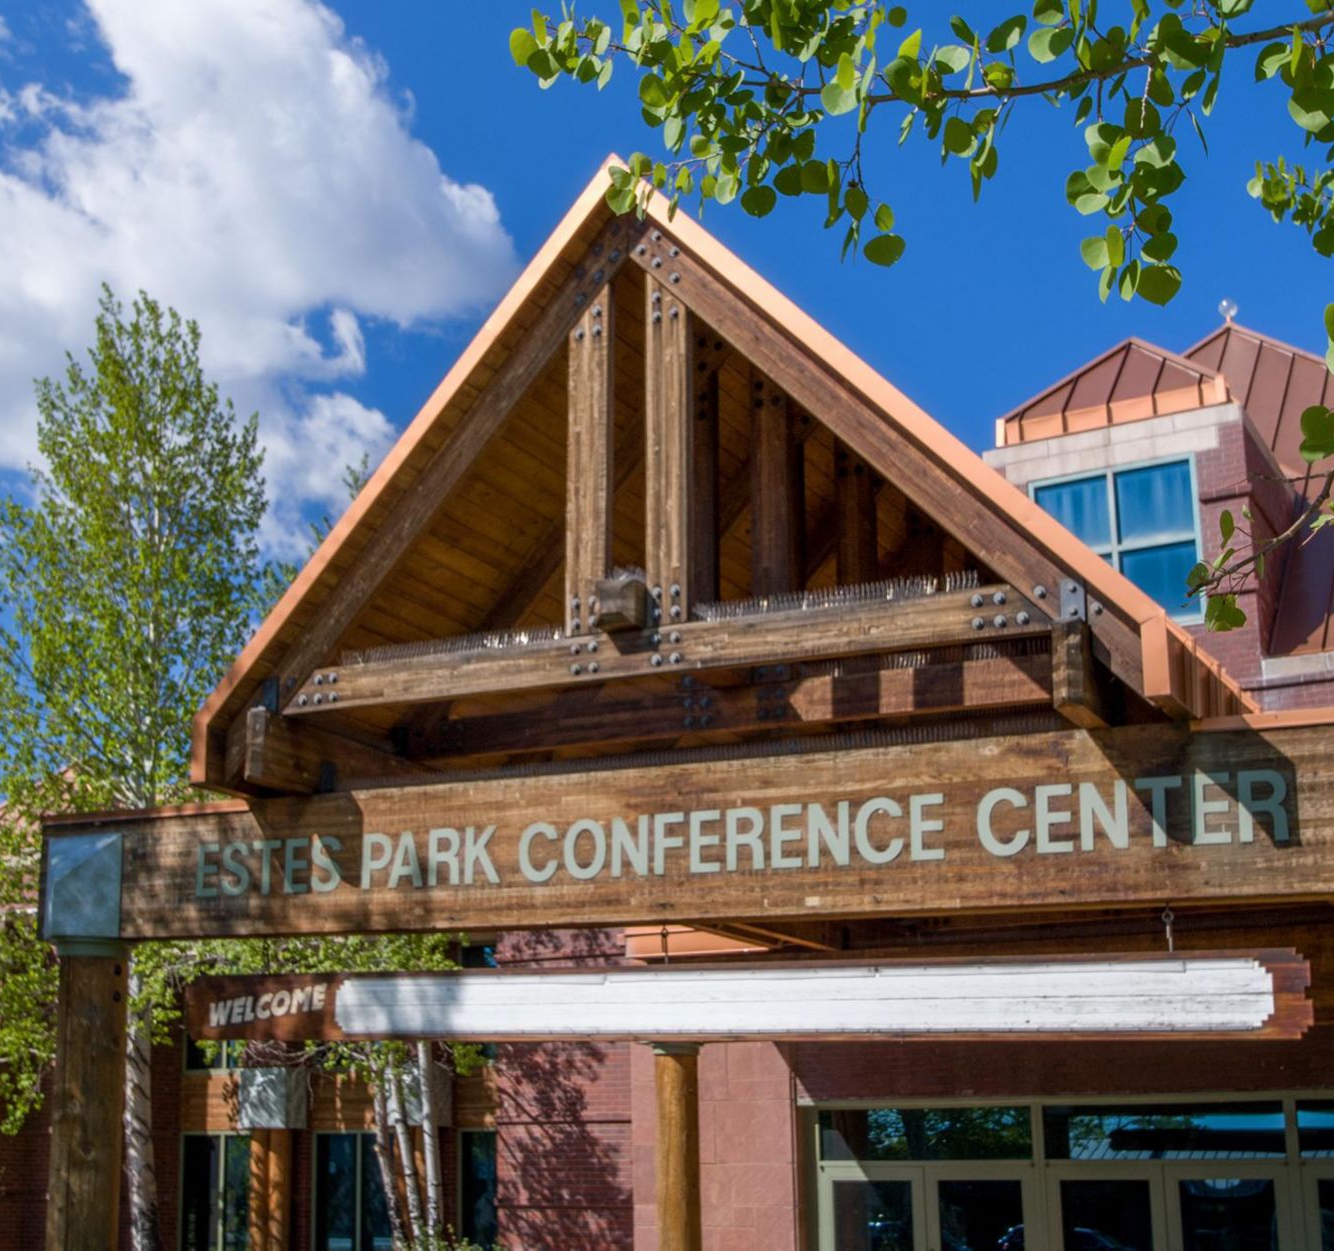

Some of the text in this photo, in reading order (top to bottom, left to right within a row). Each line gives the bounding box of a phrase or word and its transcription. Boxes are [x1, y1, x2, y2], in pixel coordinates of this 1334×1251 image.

[195, 769, 1291, 898] ESTES PARK CONFERENCE CENTER
[209, 983, 328, 1027] WELCOME
